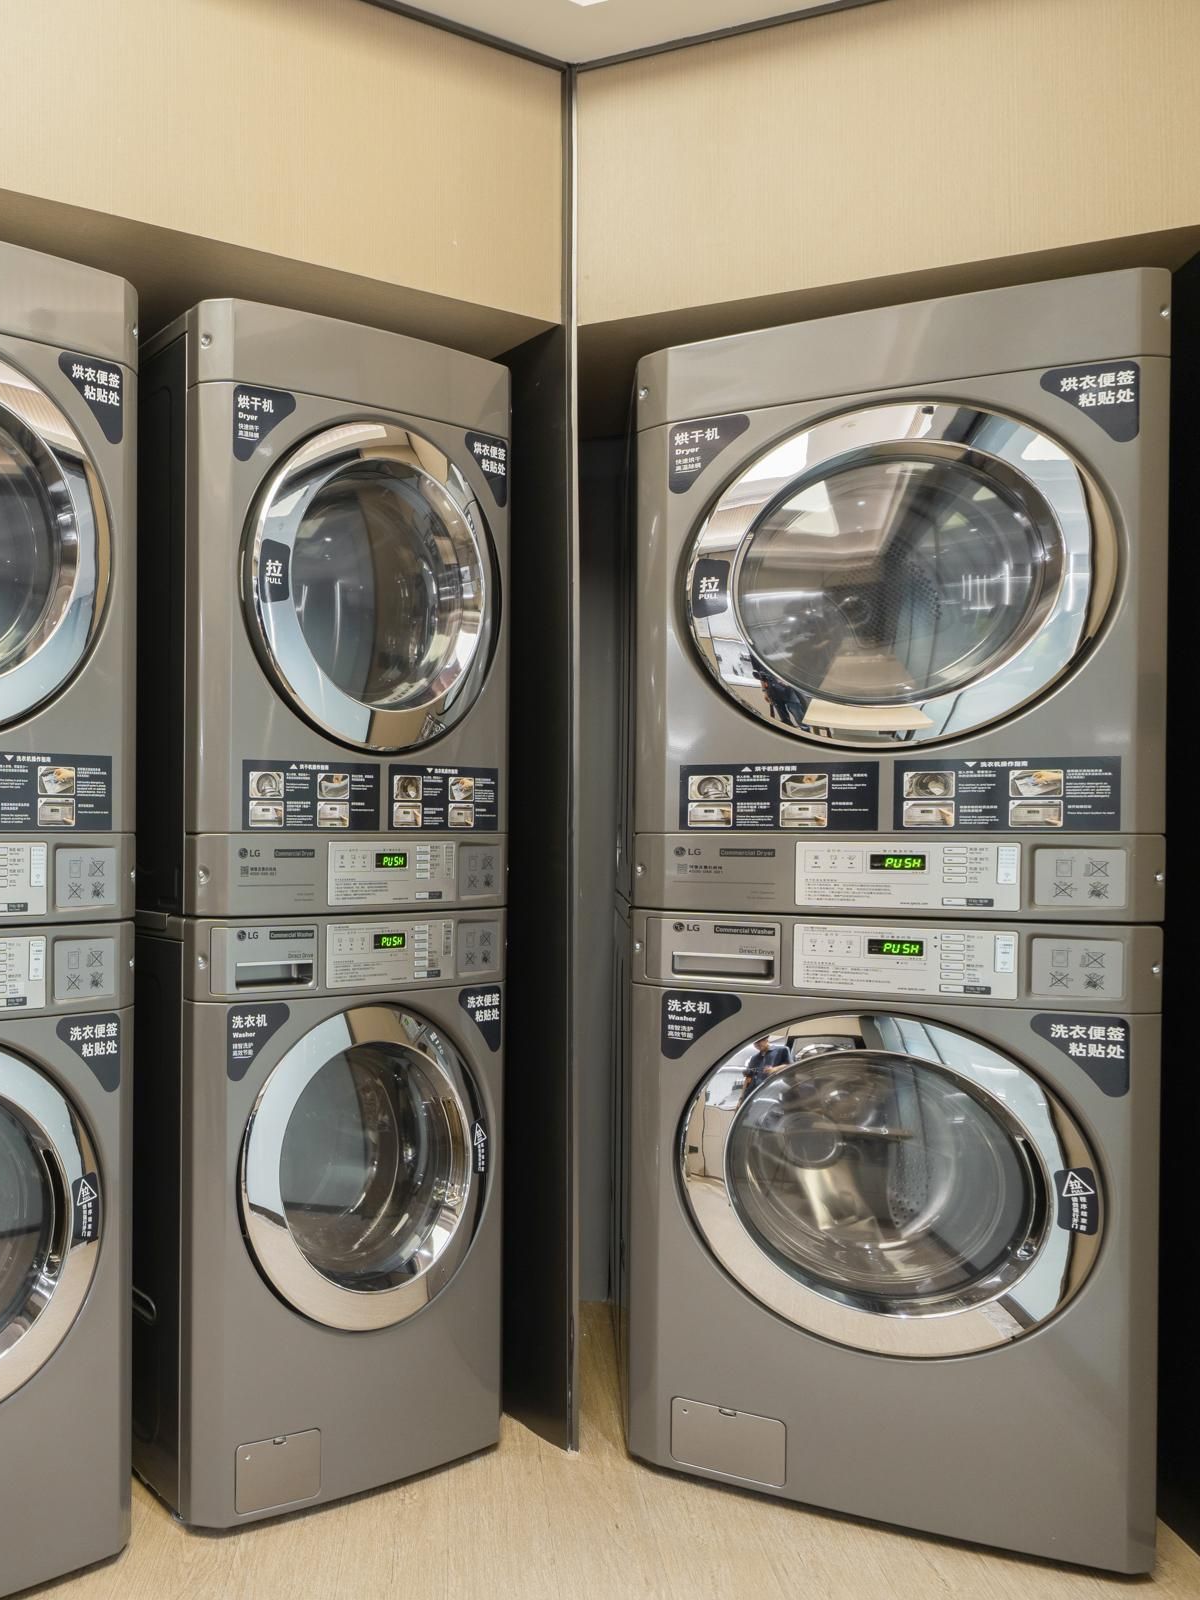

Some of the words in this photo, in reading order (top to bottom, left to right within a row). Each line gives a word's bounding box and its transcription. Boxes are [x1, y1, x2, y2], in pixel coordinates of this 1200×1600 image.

[71, 363, 120, 388] 烘衣便签
[1060, 370, 1135, 392] 烘衣便签
[84, 384, 120, 406] 粘贴处
[1078, 388, 1135, 407] 粘贴处
[237, 394, 274, 413] 烘干机
[238, 411, 258, 421] Dryer
[674, 427, 720, 446] 烘干机
[473, 441, 506, 461] 烘衣便签
[675, 447, 700, 455] Dryer
[481, 458, 506, 476] 粘贴处
[266, 559, 283, 577] 拉
[700, 576, 720, 593] 拉
[249, 850, 261, 858] LG
[688, 848, 701, 856] LG
[382, 856, 404, 866] PUSH
[884, 857, 922, 868] PUSH
[248, 931, 259, 940] LG
[687, 924, 700, 932] LG
[715, 926, 750, 934] Commercial
[751, 927, 774, 935] Washer
[381, 936, 403, 947] PUSH
[883, 943, 920, 954] PUSH
[475, 1008, 500, 1022] 粘贴处
[667, 999, 712, 1015] 洗衣机
[232, 1014, 268, 1029] 洗衣机
[668, 1014, 697, 1022] Washer
[70, 1022, 118, 1041] 洗衣便签
[1050, 1024, 1125, 1042] 洗衣便签
[82, 1040, 118, 1057] 粘贴处
[1068, 1042, 1125, 1059] 粘贴处
